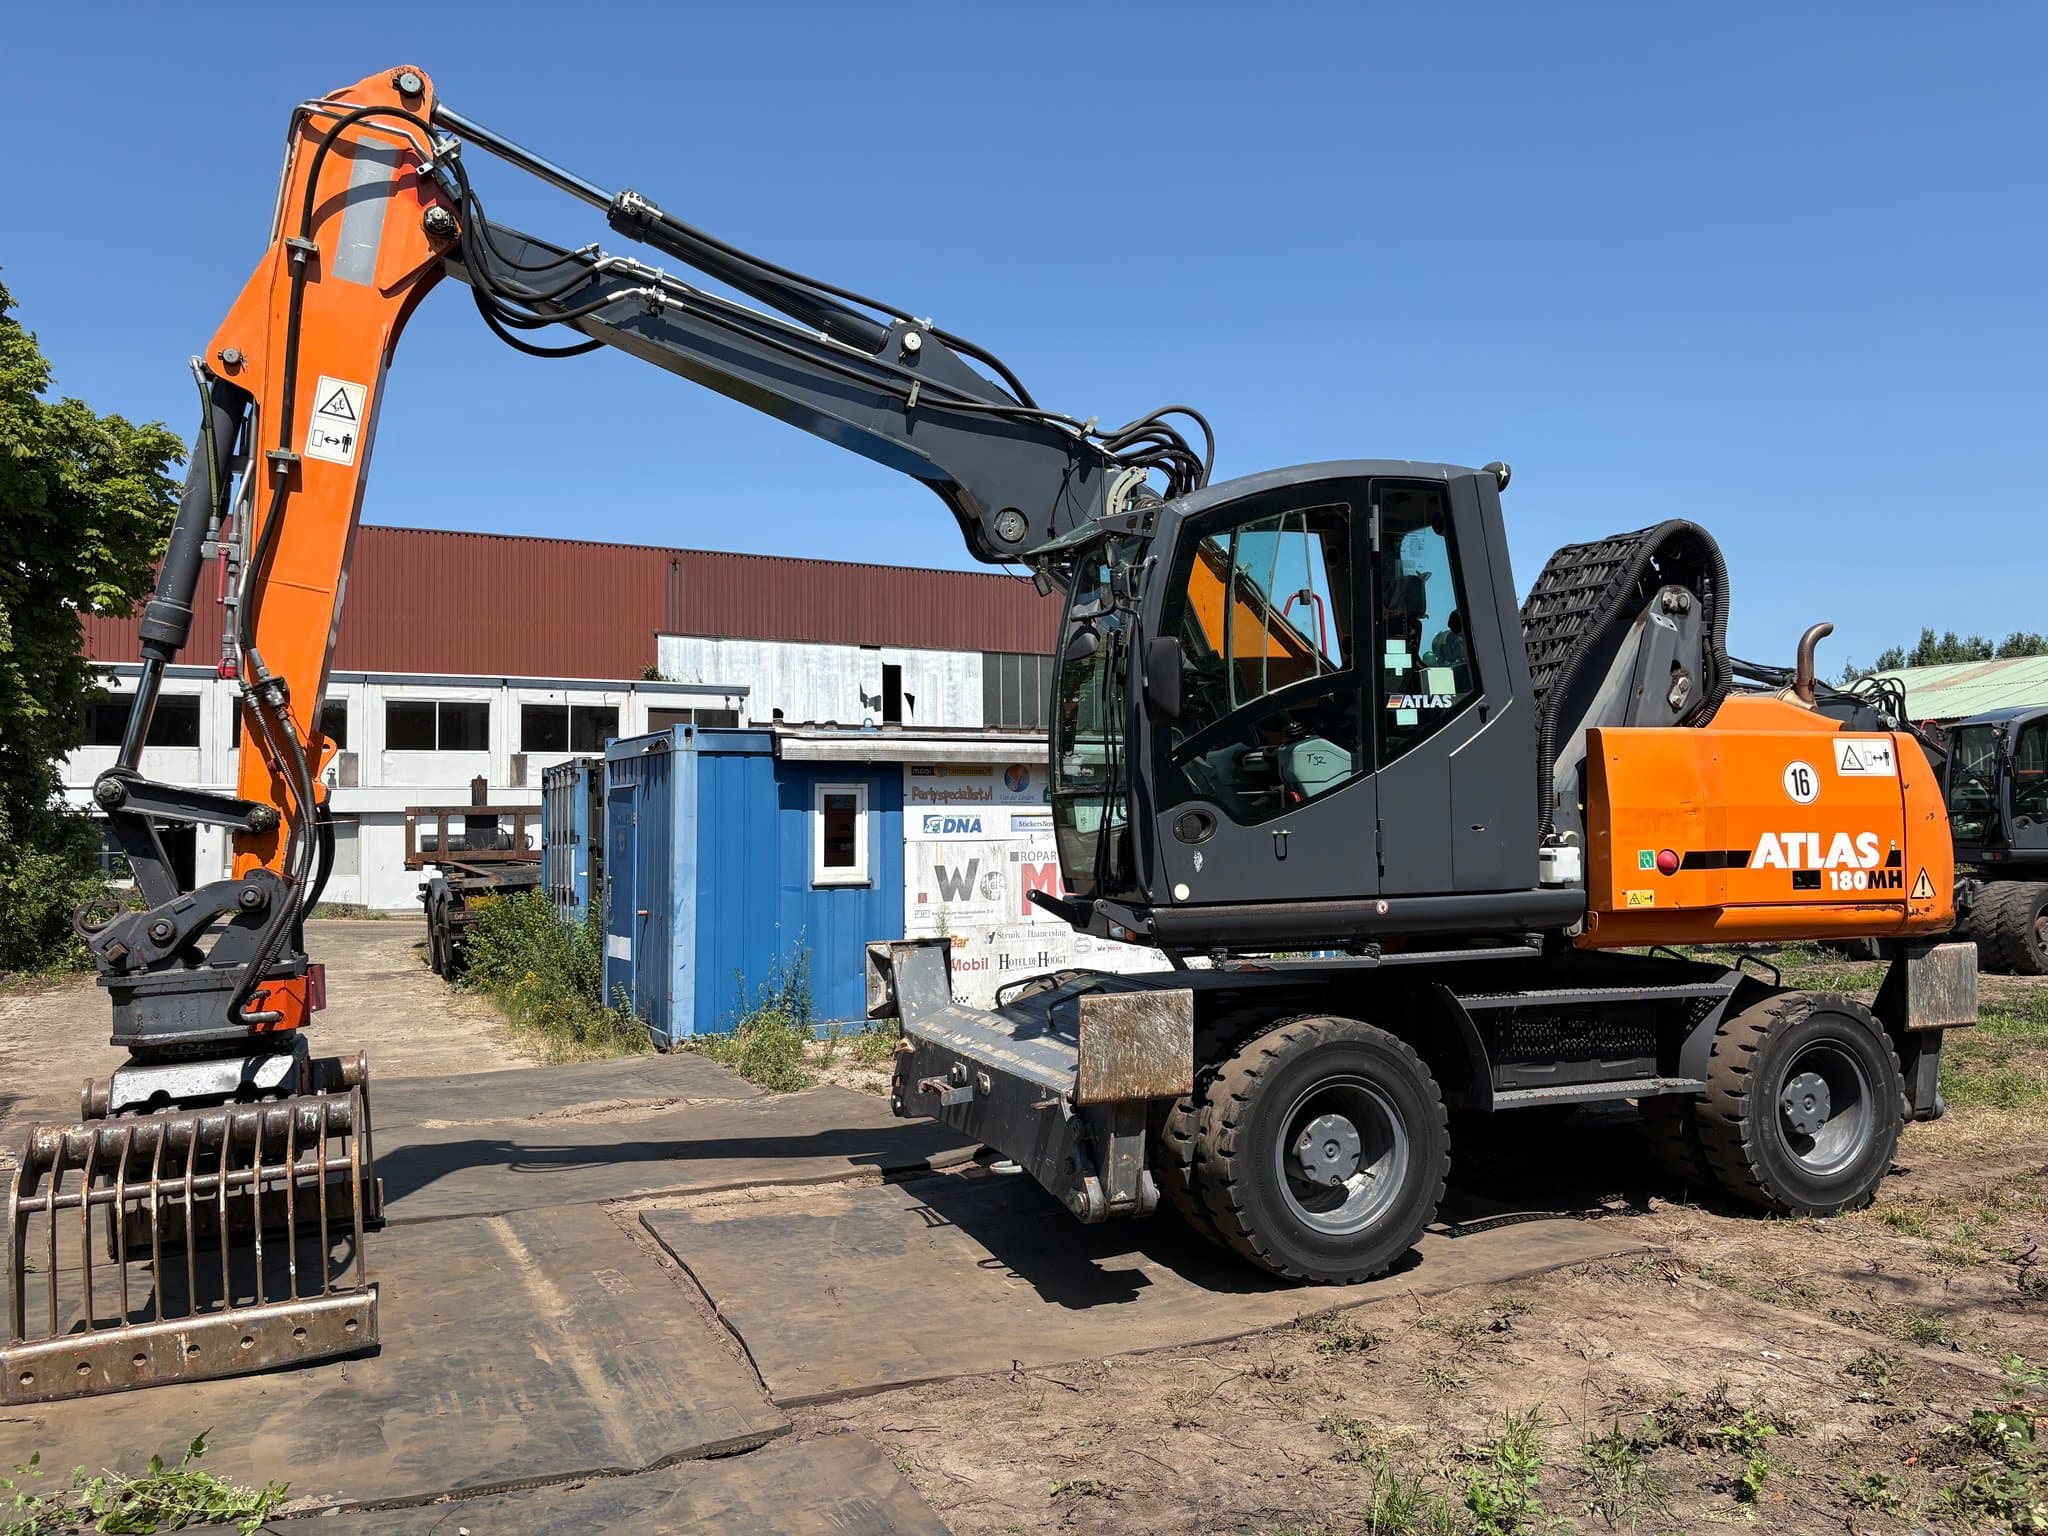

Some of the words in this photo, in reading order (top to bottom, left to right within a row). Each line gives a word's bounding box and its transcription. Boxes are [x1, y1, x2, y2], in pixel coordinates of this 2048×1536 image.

[1401, 694, 1452, 708] ATLAS
[1791, 768, 1810, 796] 16
[943, 818, 982, 833] DNA
[1750, 832, 1880, 868] ATLAS
